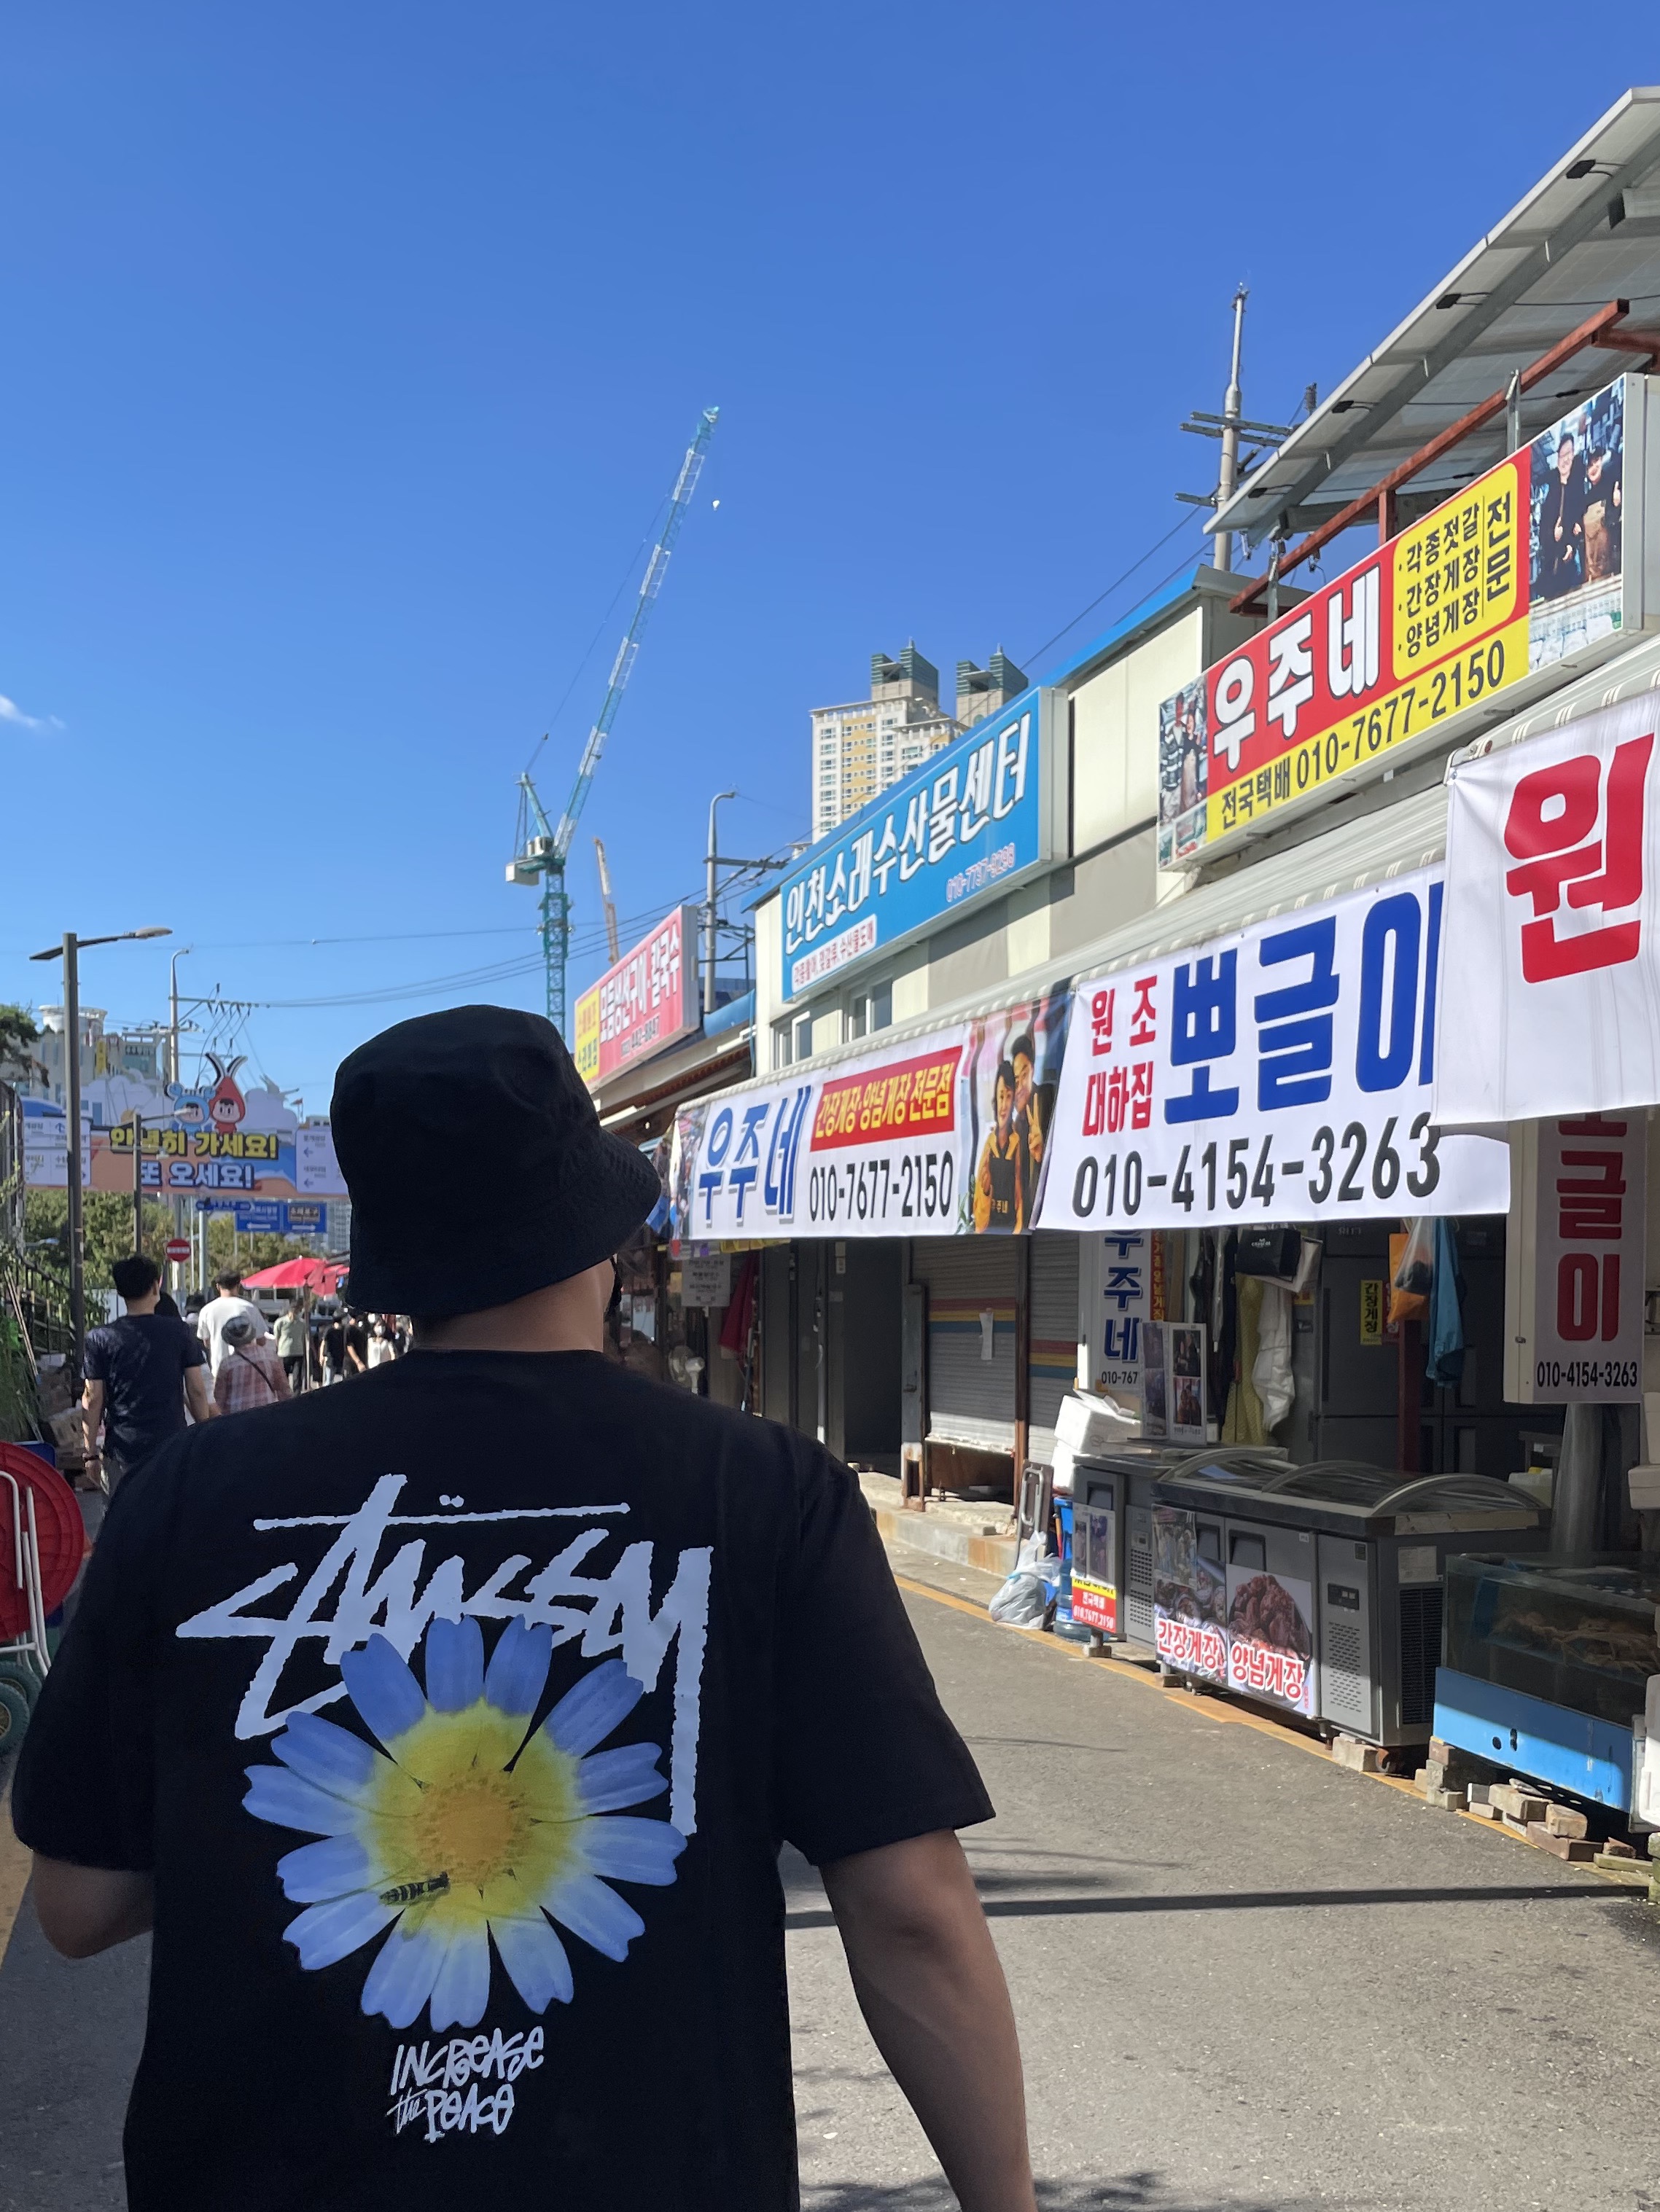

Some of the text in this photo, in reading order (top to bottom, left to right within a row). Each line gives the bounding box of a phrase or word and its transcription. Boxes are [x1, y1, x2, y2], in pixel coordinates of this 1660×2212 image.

[1487, 491, 1511, 601] 전문
[1214, 563, 1380, 773] 우주네
[1220, 641, 1505, 830] 전국택배 010-7677-2150
[1504, 732, 1654, 983] 원
[1164, 880, 1444, 1125] 뽀글이
[111, 1128, 187, 1156] 안녕히
[195, 1132, 277, 1159] 가세요!
[1082, 1060, 1153, 1136] 대하집
[169, 1162, 253, 1189] 오세요!
[700, 1085, 811, 1227] 우주네
[809, 1150, 953, 1221] 010-7677-2150
[1072, 1111, 1441, 1217] 010-4154-3263
[1537, 1361, 1637, 1388] 010-4154-3263
[1157, 1620, 1219, 1673] 간장게장
[1231, 1641, 1305, 1701] 양념게장
